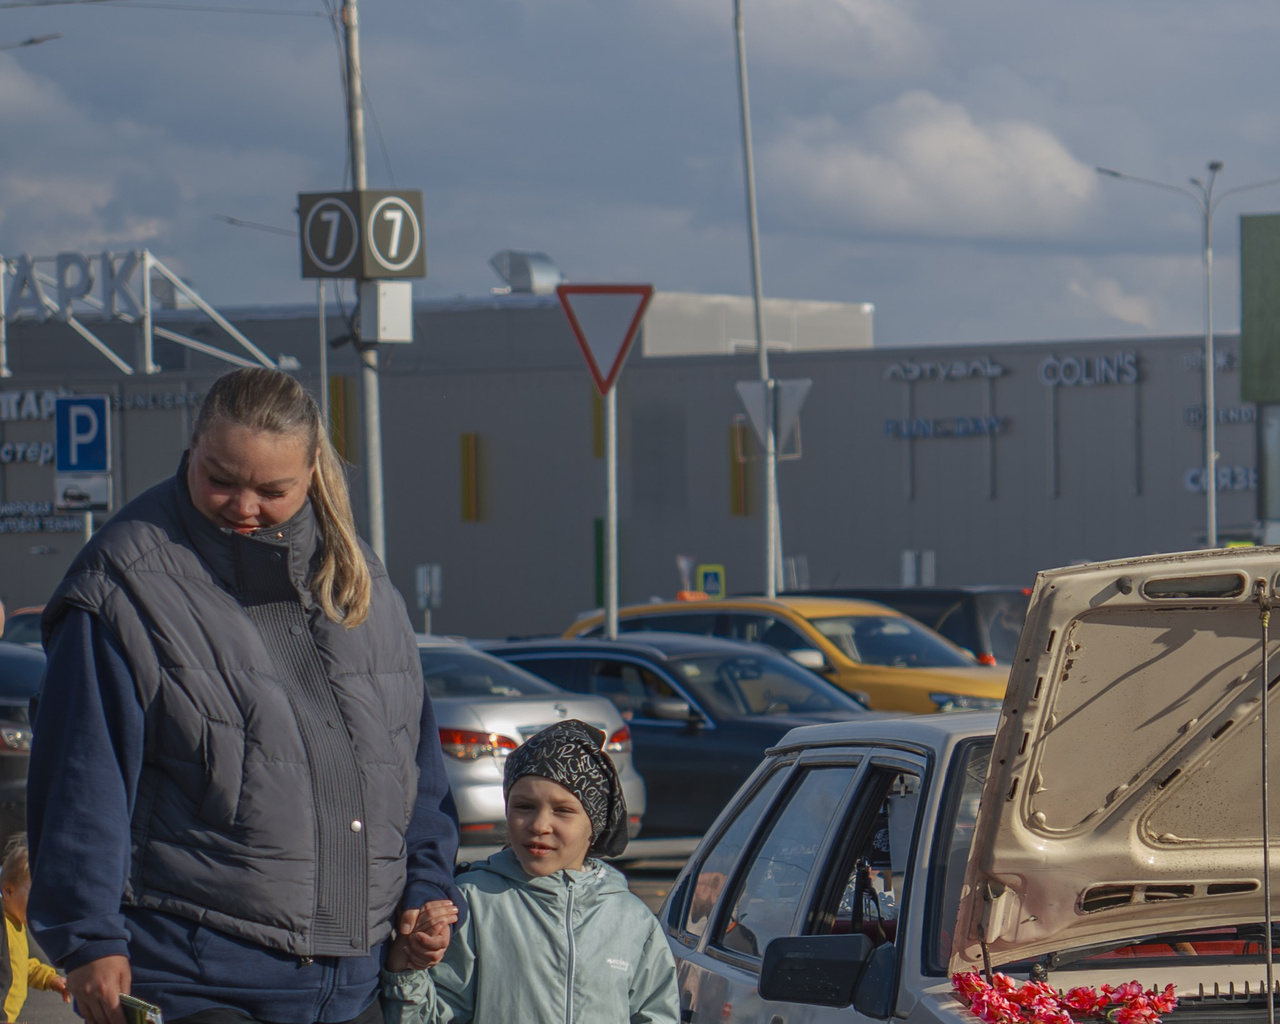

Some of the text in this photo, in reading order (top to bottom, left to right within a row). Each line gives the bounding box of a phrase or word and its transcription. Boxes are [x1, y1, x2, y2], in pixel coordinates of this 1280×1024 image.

[321, 210, 340, 259] 7
[383, 209, 403, 258] 7
[1041, 352, 1137, 386] COLIN'S
[69, 404, 98, 465] P
